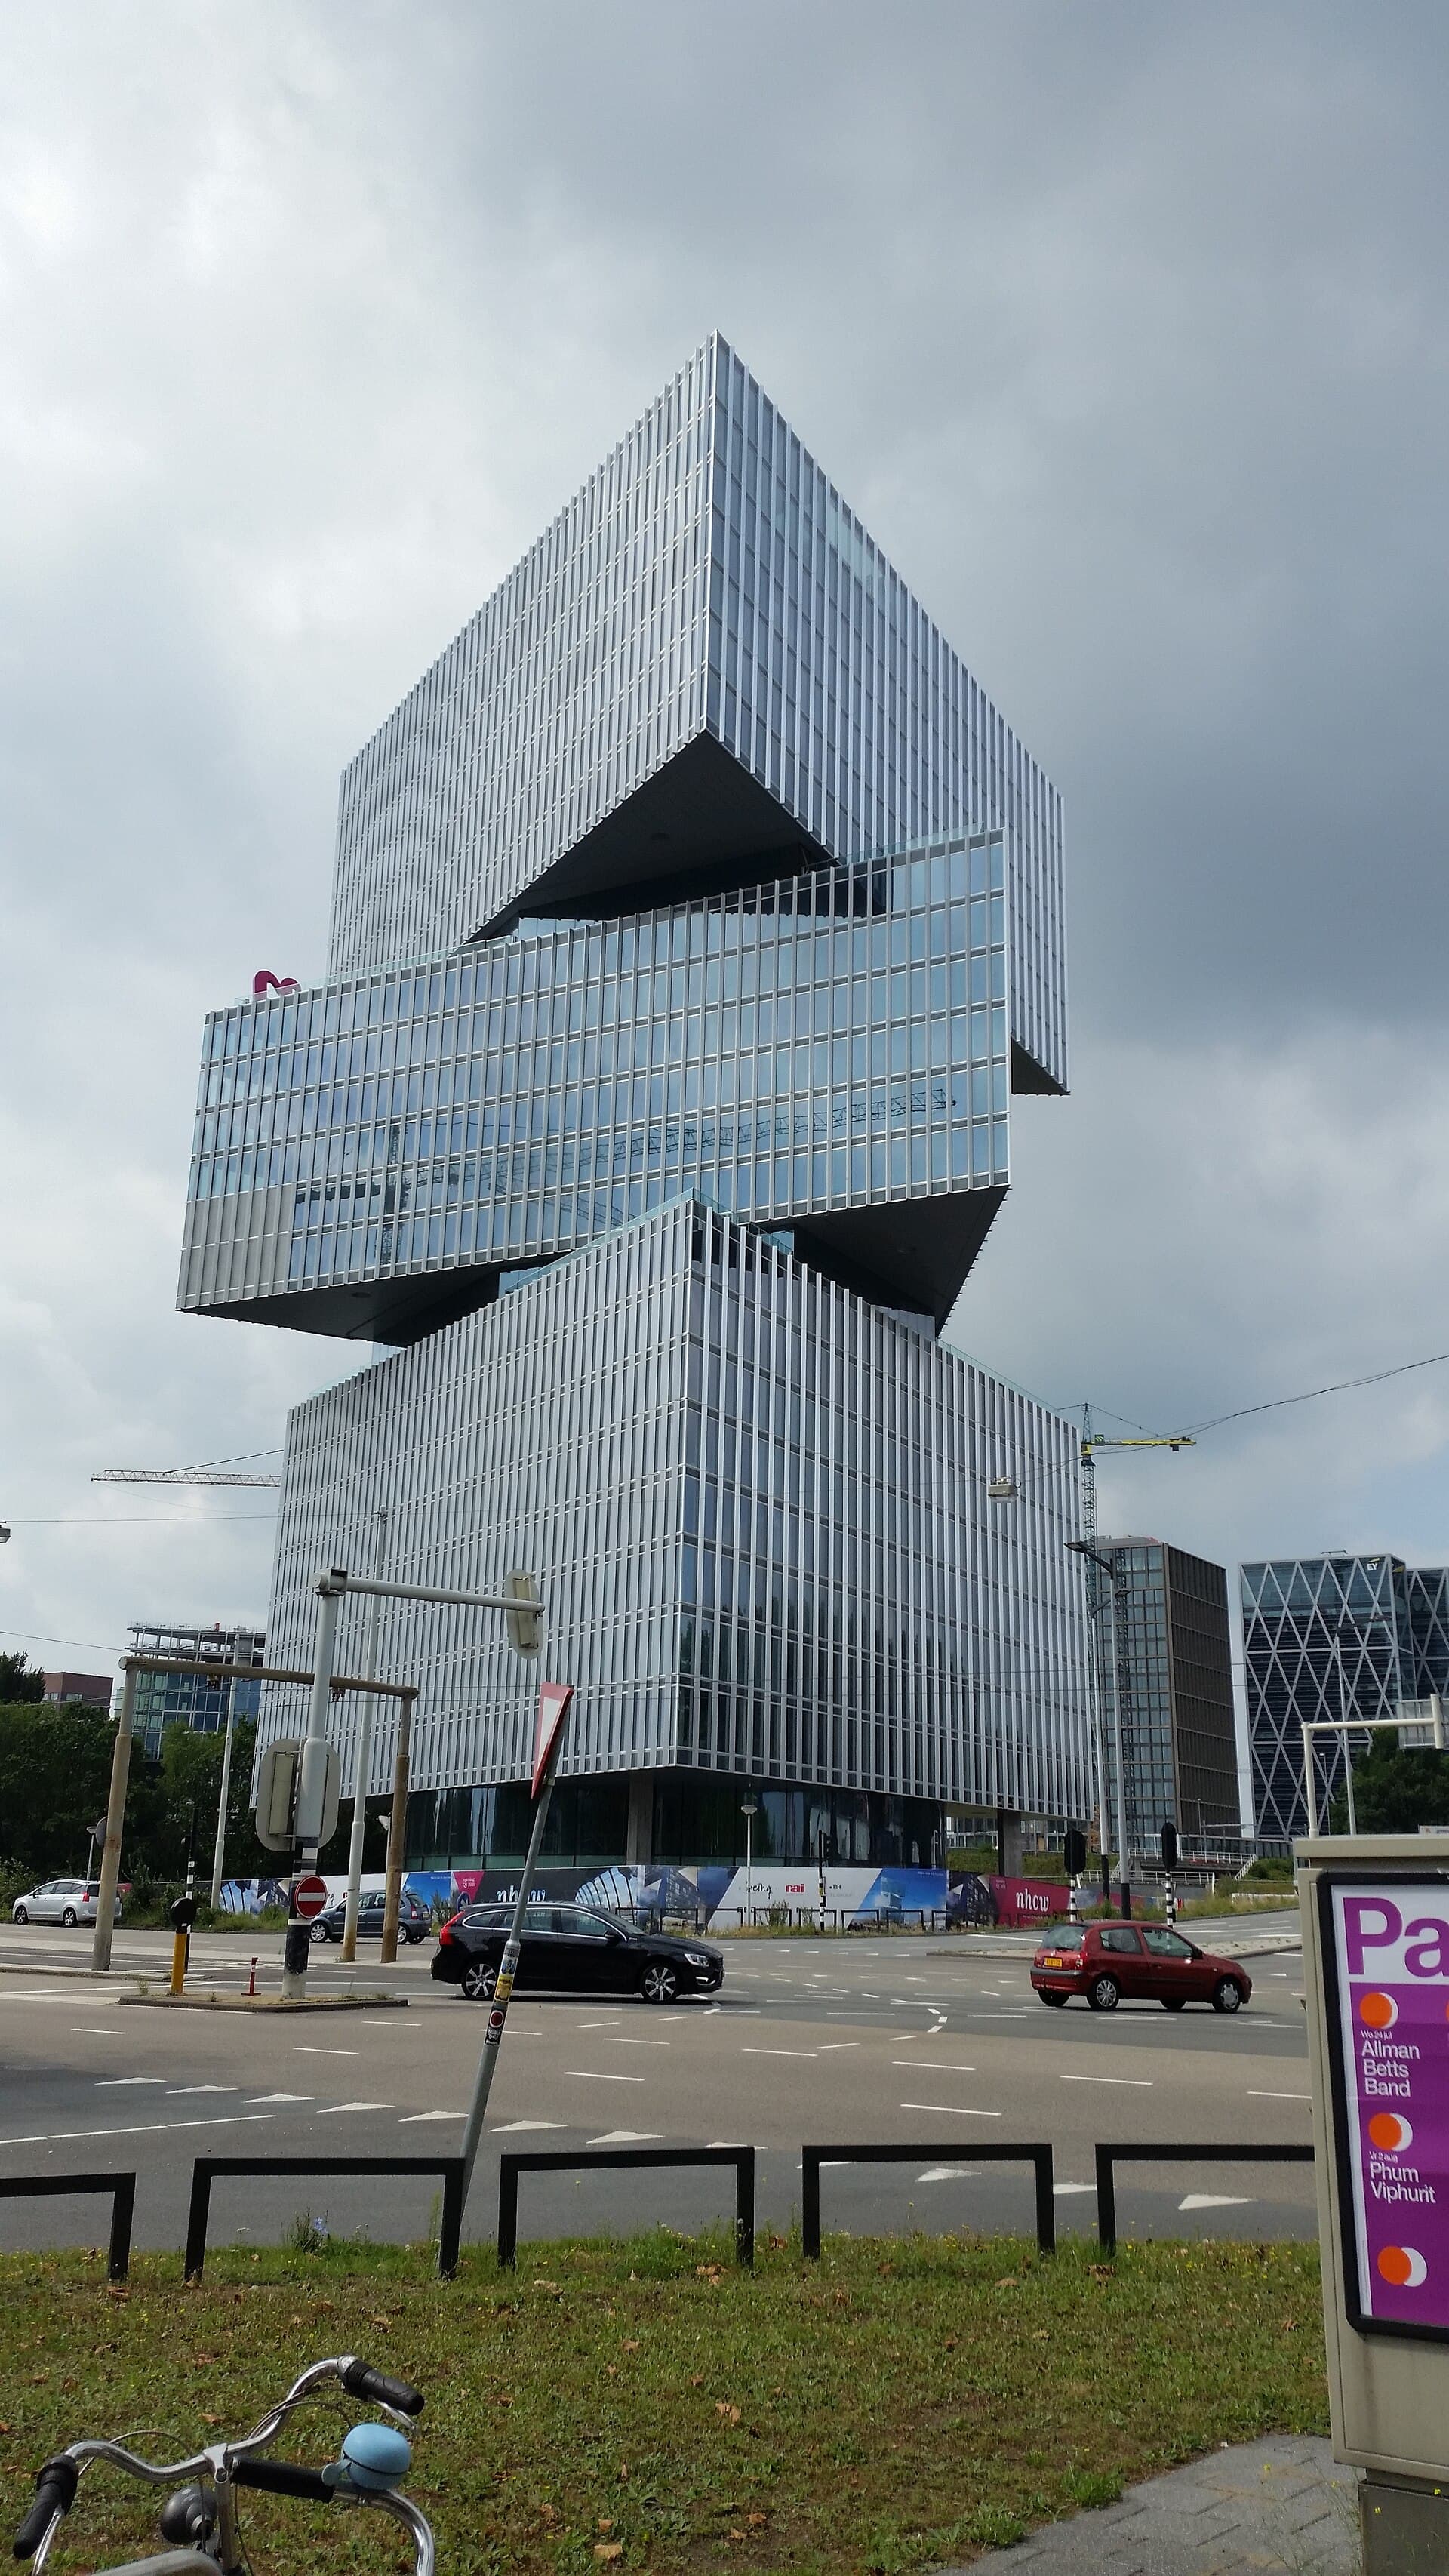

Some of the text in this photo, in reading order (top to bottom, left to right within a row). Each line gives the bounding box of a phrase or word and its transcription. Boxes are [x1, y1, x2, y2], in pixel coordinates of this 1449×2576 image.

[1367, 1562, 1378, 1571] EY
[496, 1885, 546, 1902] nhw
[785, 1883, 805, 1893] rai
[1016, 1888, 1050, 1912] nhow
[1343, 1897, 1449, 1977] Pa
[1361, 2039, 1420, 2060] Allman
[1363, 2058, 1410, 2079] Betts
[1364, 2077, 1411, 2097] Band
[1383, 2154, 1398, 2164] aug
[1370, 2161, 1420, 2183] Phum
[1370, 2181, 1436, 2204] Viphurit
